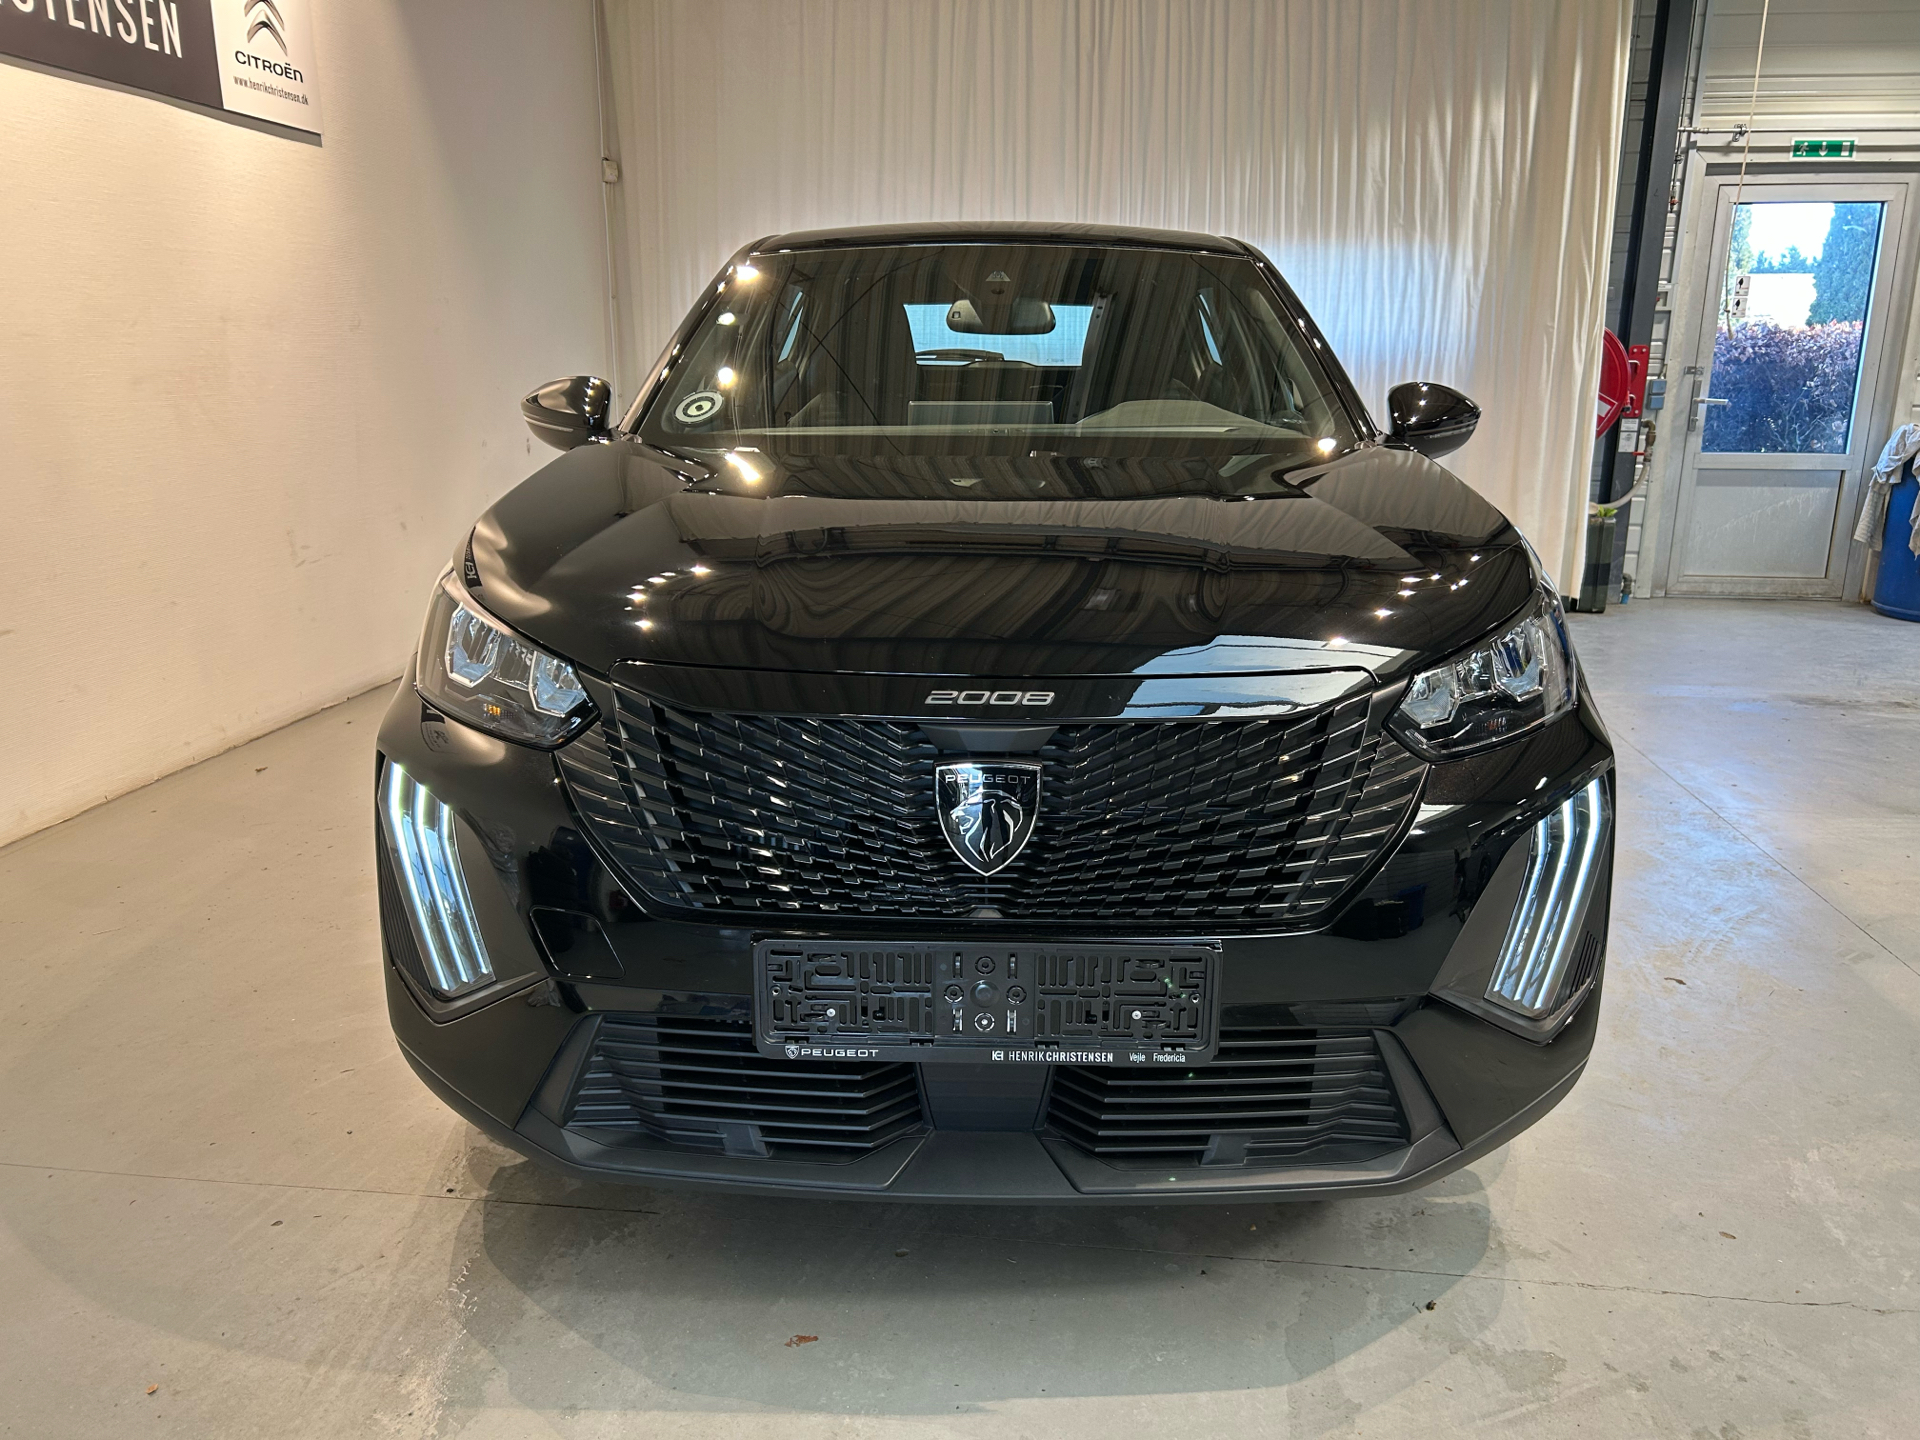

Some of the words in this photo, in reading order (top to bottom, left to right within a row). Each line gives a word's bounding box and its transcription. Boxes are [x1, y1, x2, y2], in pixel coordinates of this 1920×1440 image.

[12, 0, 182, 58] ENSEN
[235, 50, 304, 83] CITROËN
[233, 75, 309, 106] www.henrikchristensen.dk
[924, 690, 1055, 706] 2008
[945, 773, 1031, 785] PEUGEOT
[801, 1048, 879, 1057] PEUGEOT
[1129, 1053, 1146, 1063] Vejle
[1153, 1053, 1186, 1063] Fredericia
